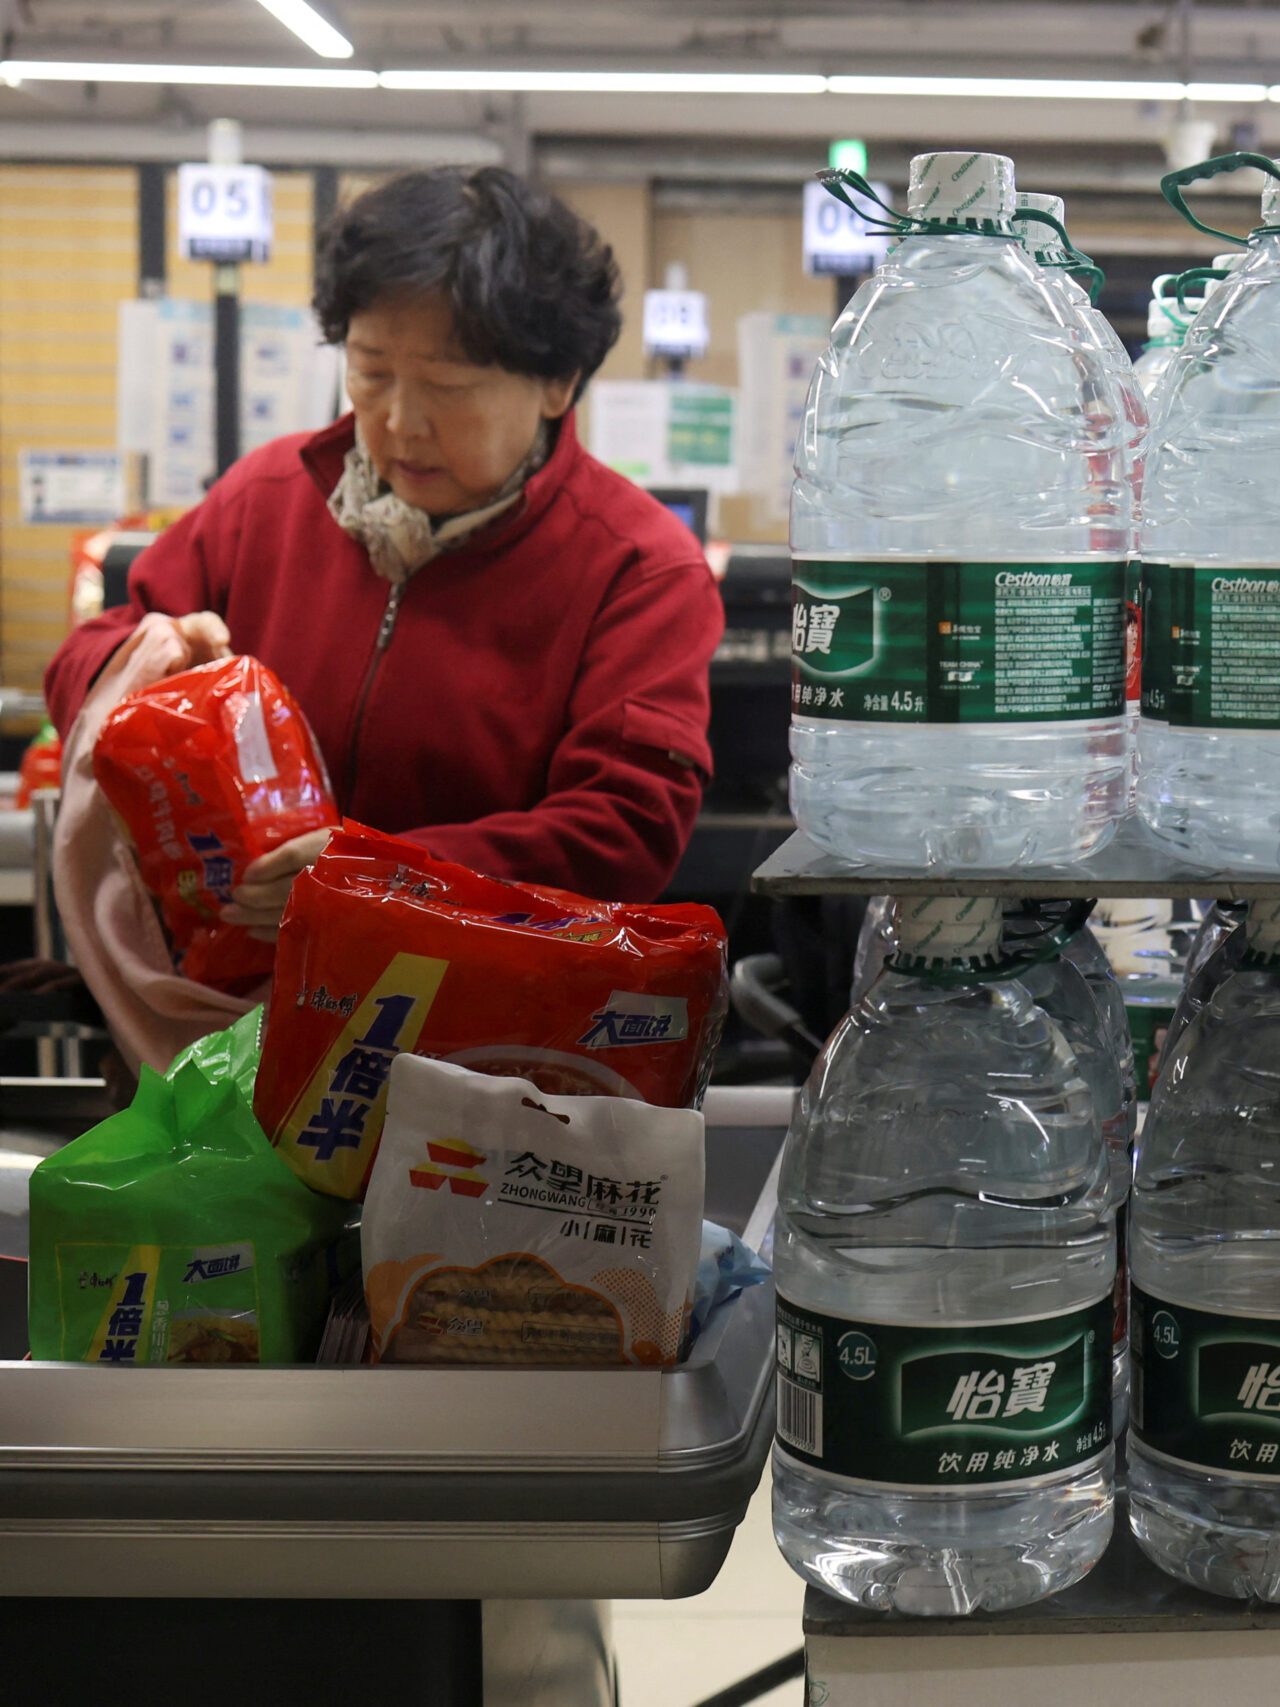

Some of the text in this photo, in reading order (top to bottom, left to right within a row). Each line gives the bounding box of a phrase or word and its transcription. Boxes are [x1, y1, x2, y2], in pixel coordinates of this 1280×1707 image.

[192, 179, 249, 218] 05
[296, 994, 417, 1161] 1倍半
[500, 1182, 587, 1208] ZHONGWANG
[505, 1151, 662, 1206] 众望麻花
[1153, 1325, 1179, 1345] 4.5L
[839, 1347, 876, 1366] 4.5L
[945, 1361, 1057, 1421] 怡寶
[937, 1440, 1060, 1474] 饮用纯净水
